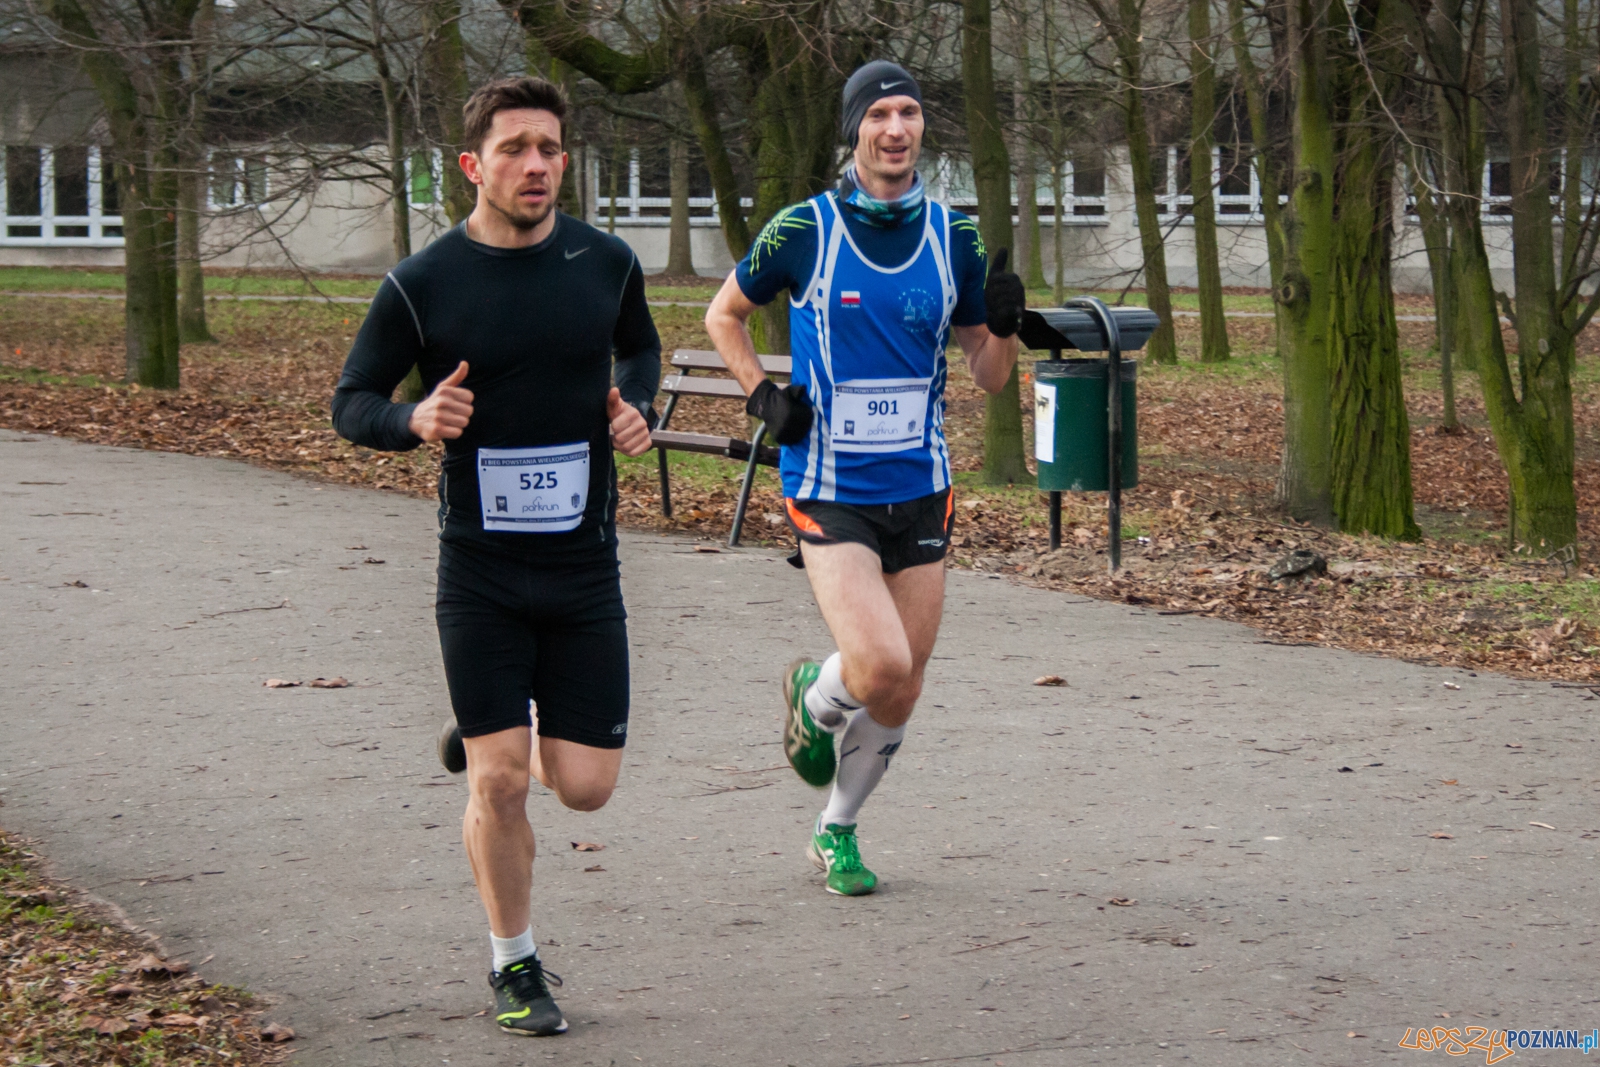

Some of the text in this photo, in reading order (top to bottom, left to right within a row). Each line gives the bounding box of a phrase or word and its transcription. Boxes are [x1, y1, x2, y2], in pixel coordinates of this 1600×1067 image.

[867, 400, 899, 416] 901
[867, 421, 899, 437] parkrun
[501, 458, 537, 466] POWSTANIA
[537, 452, 586, 464] WIELKOPOLSKIEGO
[520, 471, 558, 490] 525
[522, 496, 560, 514] parkrun
